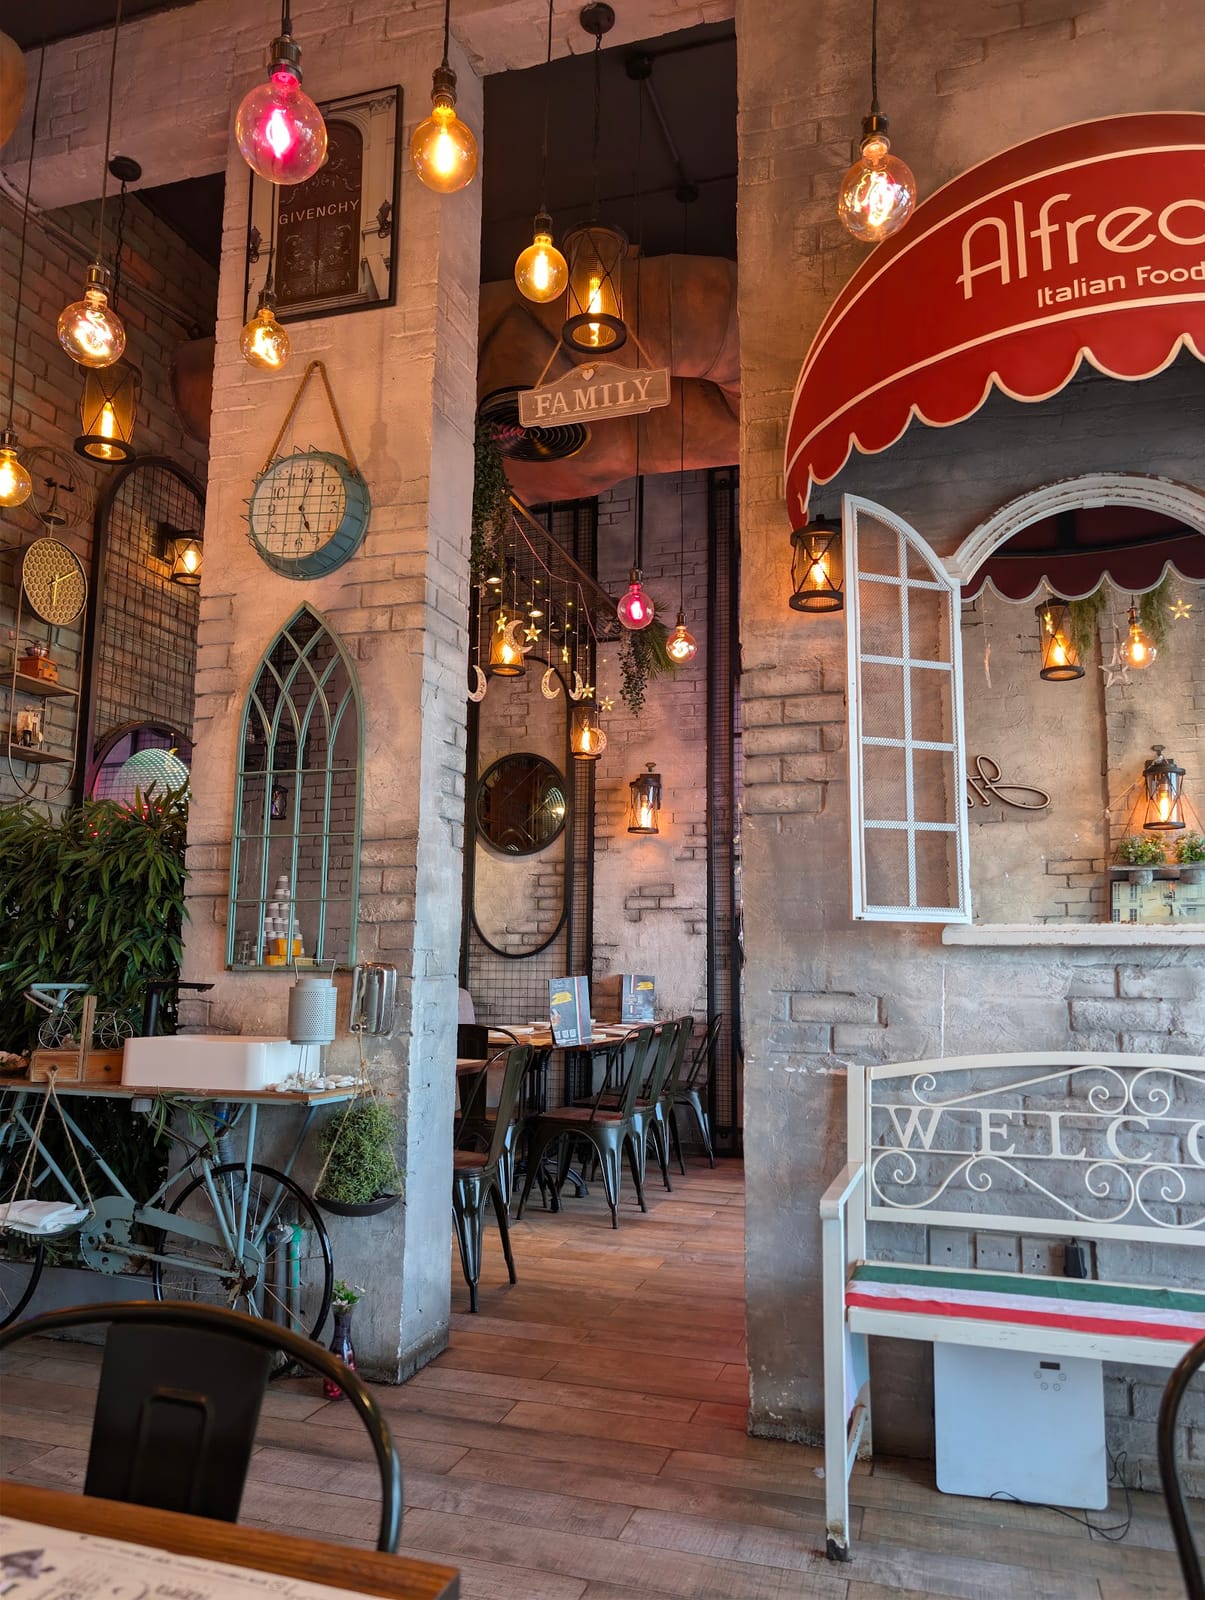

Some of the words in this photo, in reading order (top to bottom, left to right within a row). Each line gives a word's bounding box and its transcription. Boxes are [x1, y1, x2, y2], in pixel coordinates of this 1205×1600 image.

[279, 199, 360, 225] GIVENCHY
[1037, 275, 1126, 308] Italian
[1136, 261, 1205, 286] Food
[535, 377, 652, 418] FAMILY
[301, 467, 313, 480] 12
[273, 486, 286, 500] 10
